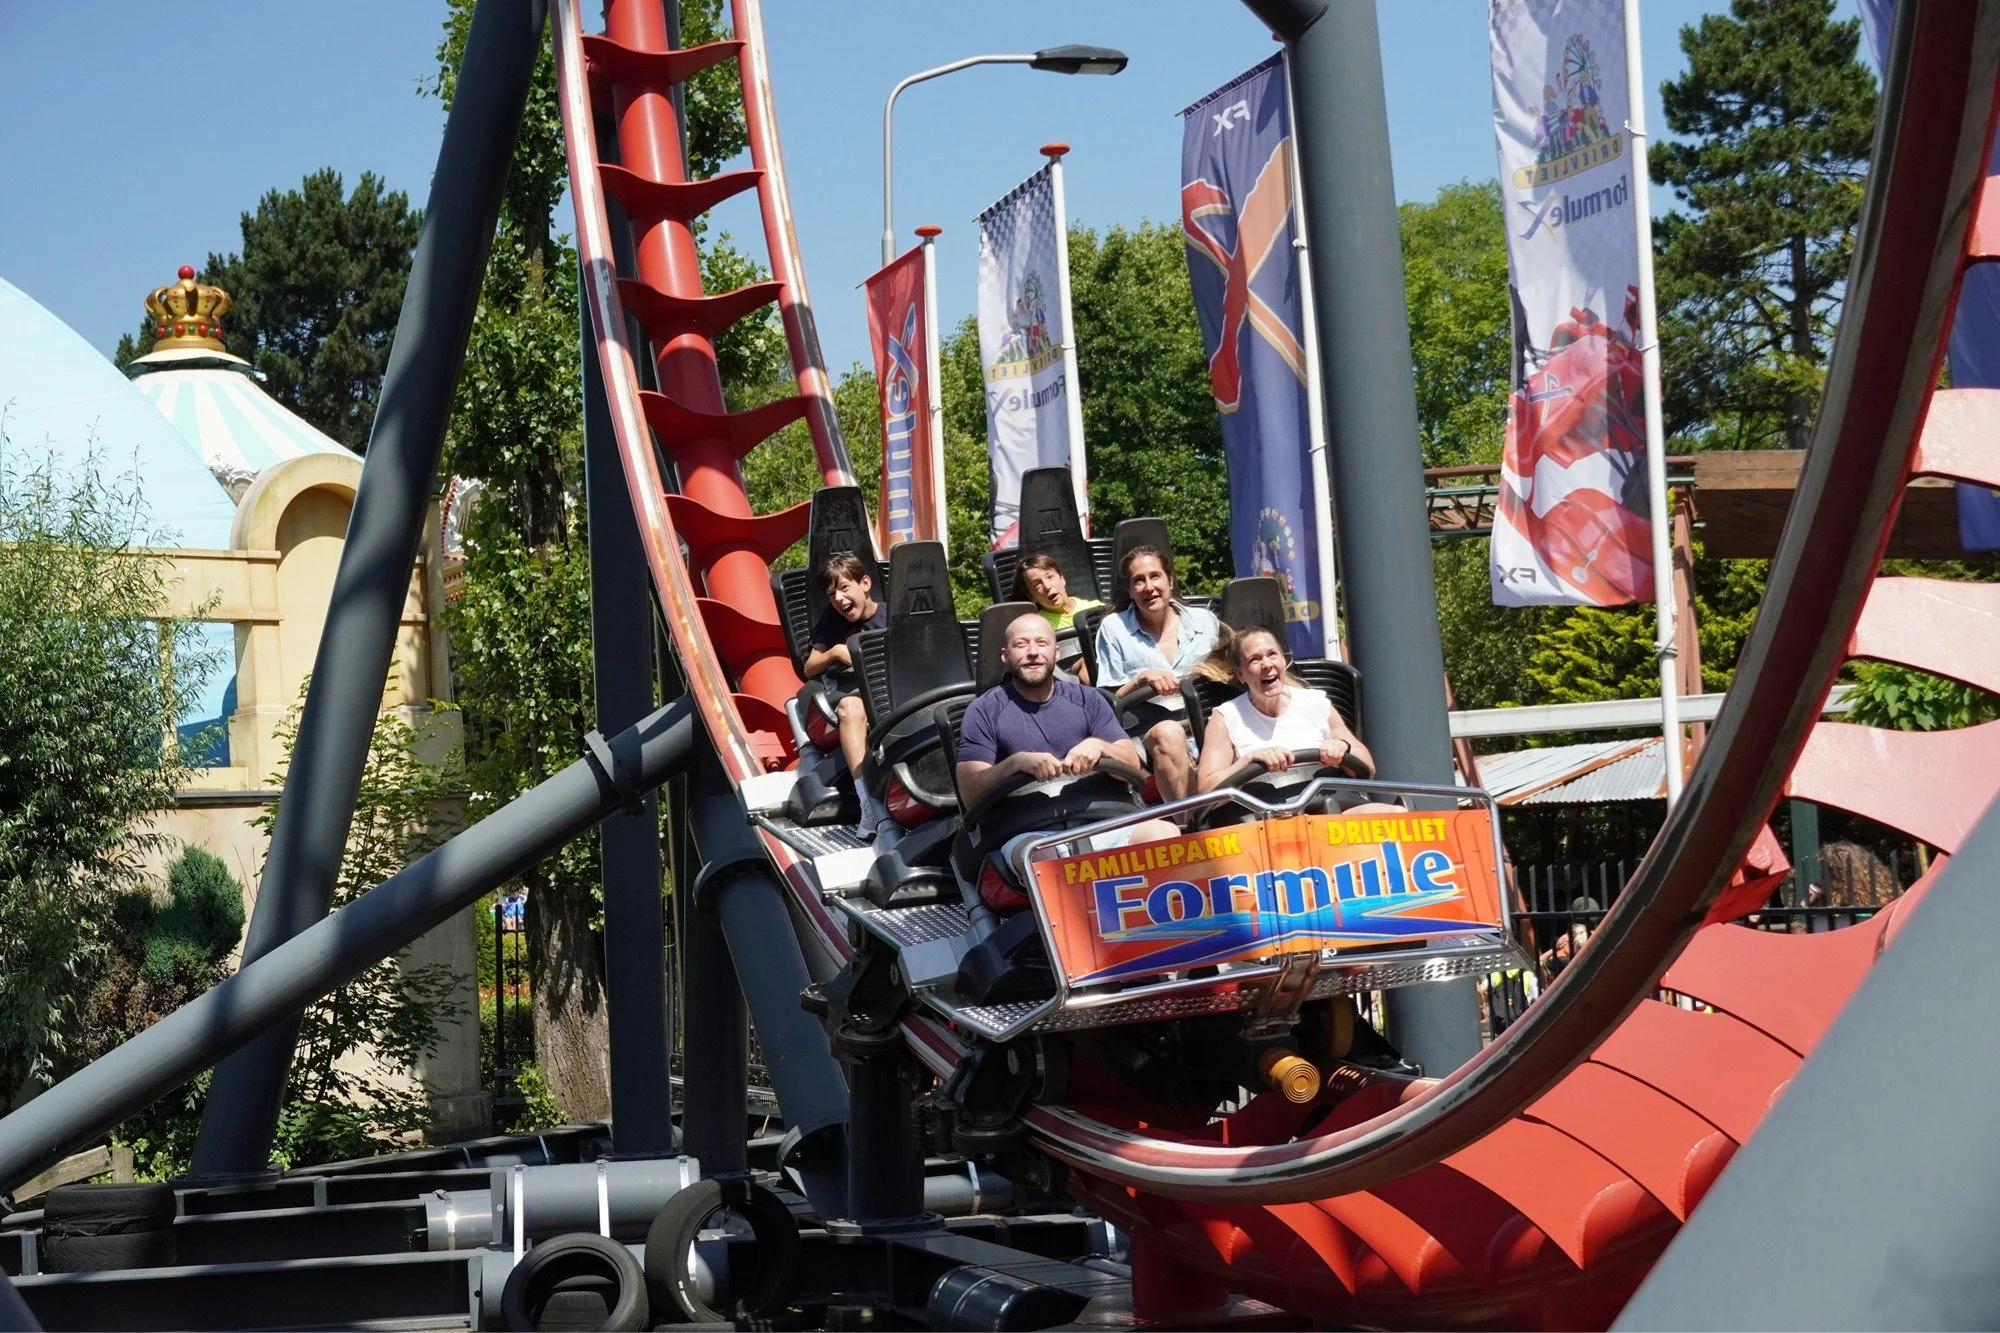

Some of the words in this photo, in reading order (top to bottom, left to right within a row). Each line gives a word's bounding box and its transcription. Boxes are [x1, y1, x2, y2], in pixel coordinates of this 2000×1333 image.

[1063, 831, 1241, 886] FAMILIEPARK
[1327, 817, 1447, 846] DRIEVLIET
[1092, 841, 1457, 938] Formule
